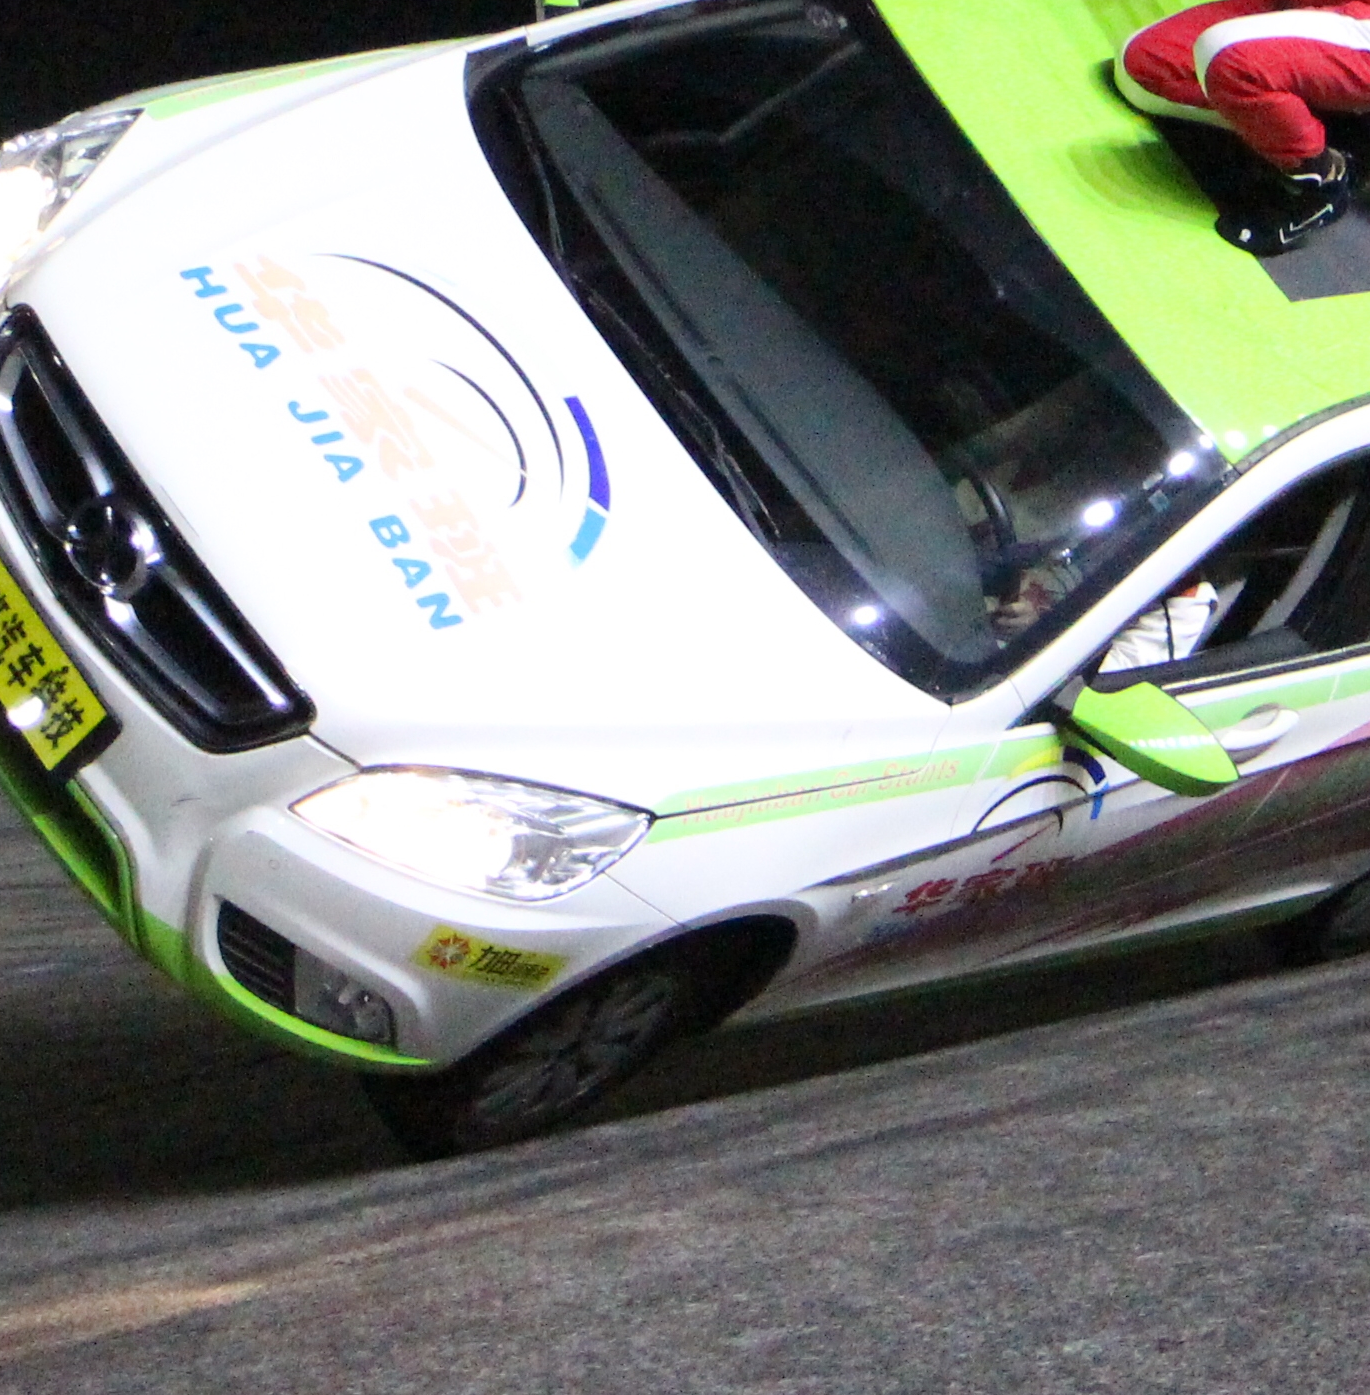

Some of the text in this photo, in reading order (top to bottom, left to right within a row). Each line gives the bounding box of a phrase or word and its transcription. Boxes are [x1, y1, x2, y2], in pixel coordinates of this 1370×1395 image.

[179, 265, 464, 631] HUA JIA BAN
